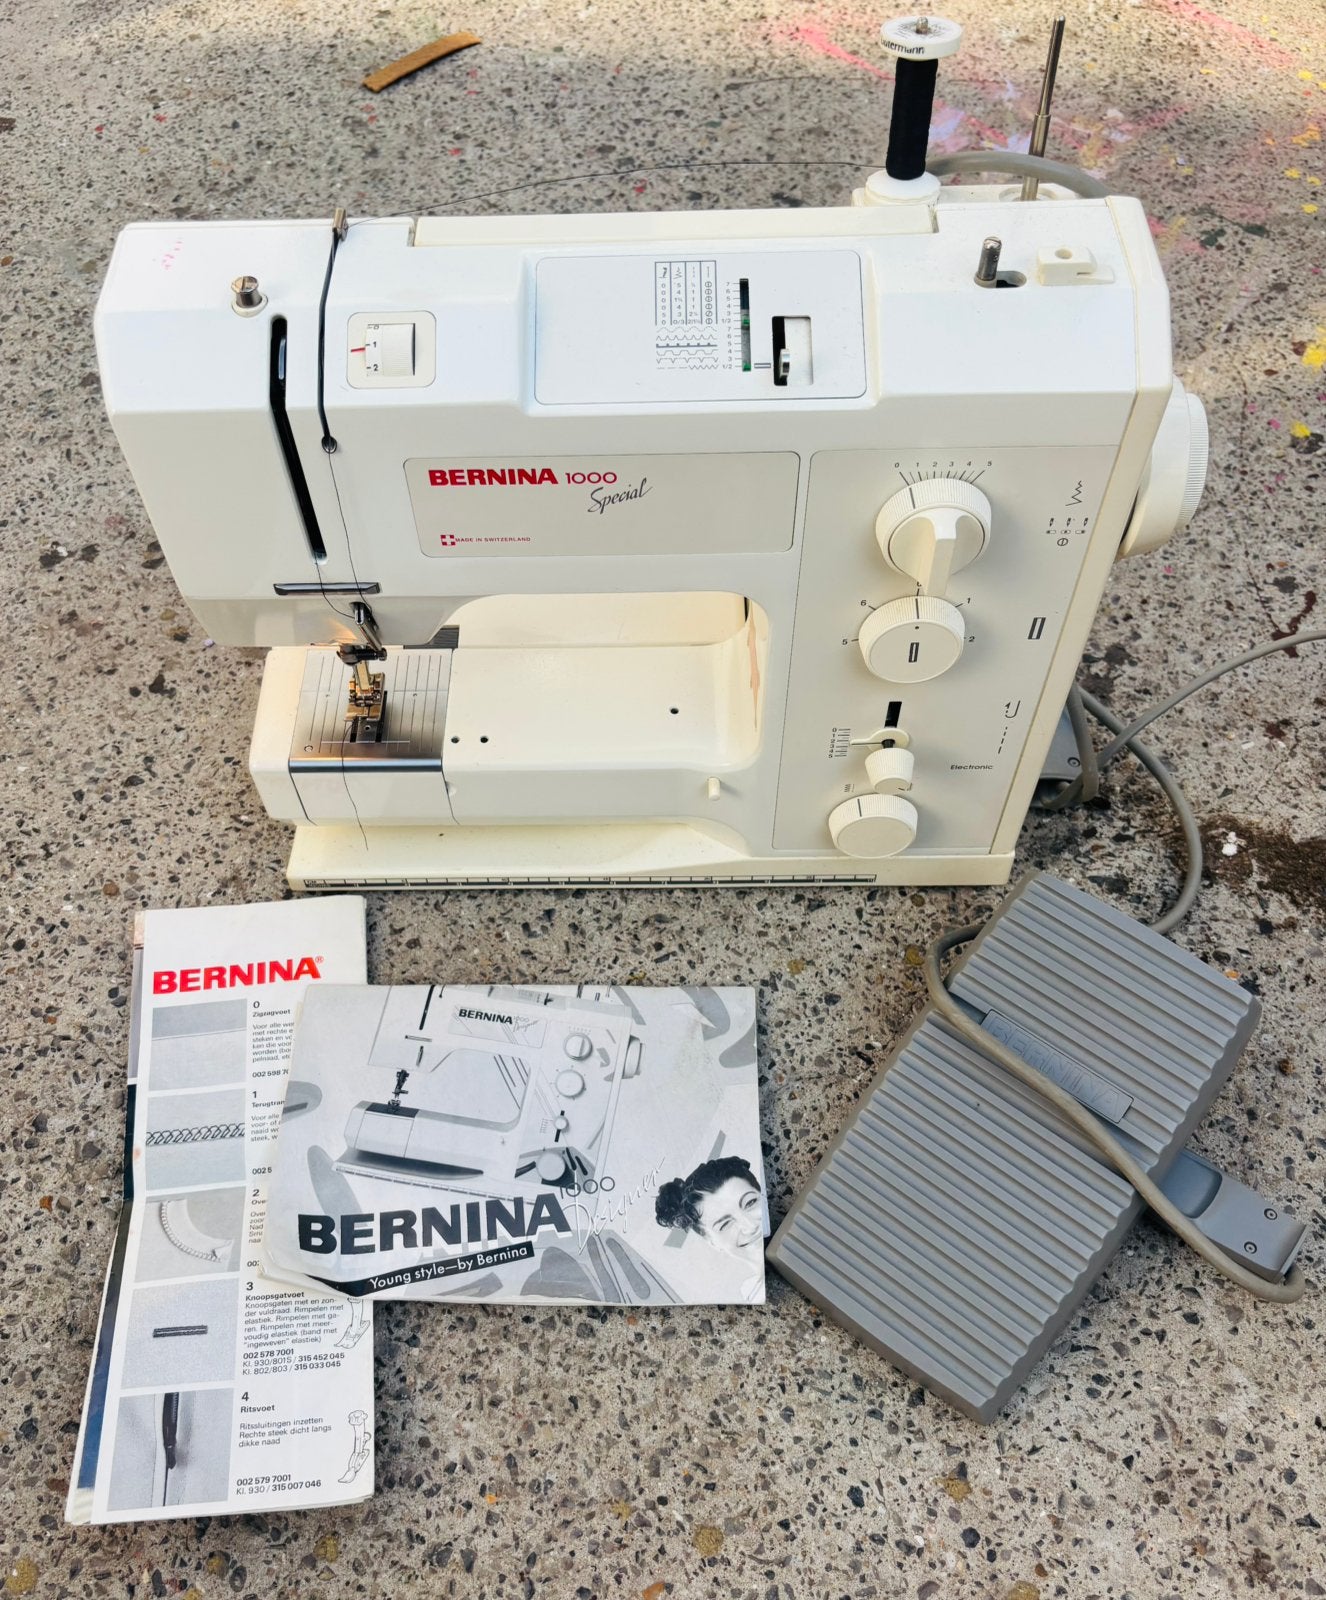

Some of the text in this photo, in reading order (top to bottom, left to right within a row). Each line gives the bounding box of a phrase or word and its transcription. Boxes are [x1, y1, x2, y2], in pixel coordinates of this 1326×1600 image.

[373, 364, 379, 372] 2
[428, 468, 617, 486] BERNINA 1000
[587, 477, 653, 514] Special
[253, 1001, 260, 1009] 0
[252, 1009, 290, 1018] Zigzagvoet
[459, 1008, 513, 1025] BERNINA
[252, 1091, 257, 1099] 1
[252, 1189, 260, 1197] 2
[298, 1176, 616, 1256] BERNINA 1000
[370, 1272, 411, 1289] Young
[477, 1246, 528, 1266] Bernina
[246, 1282, 254, 1291] 3
[246, 1292, 304, 1301] Knoopsgatvoet
[246, 1300, 293, 1309] Knoopsgaten
[244, 1310, 257, 1318] der
[258, 1307, 291, 1316] vuldraad.
[294, 1306, 328, 1314] Rimpelen
[244, 1316, 274, 1325] elastiek.
[276, 1314, 310, 1323] Rimpelen
[328, 1313, 340, 1321] ga-
[261, 1323, 294, 1332] Rimpelen
[244, 1332, 269, 1341] voudig
[271, 1330, 298, 1338] elastiek
[300, 1328, 321, 1336] (band
[291, 1336, 322, 1344] elastiek)
[241, 1392, 250, 1402] 4
[240, 1405, 275, 1413] Ritsvoet
[240, 1417, 323, 1430] Ritssluitingen inzetten
[240, 1425, 332, 1439] Rechte steek dicht langs
[239, 1438, 281, 1448] dikke naad
